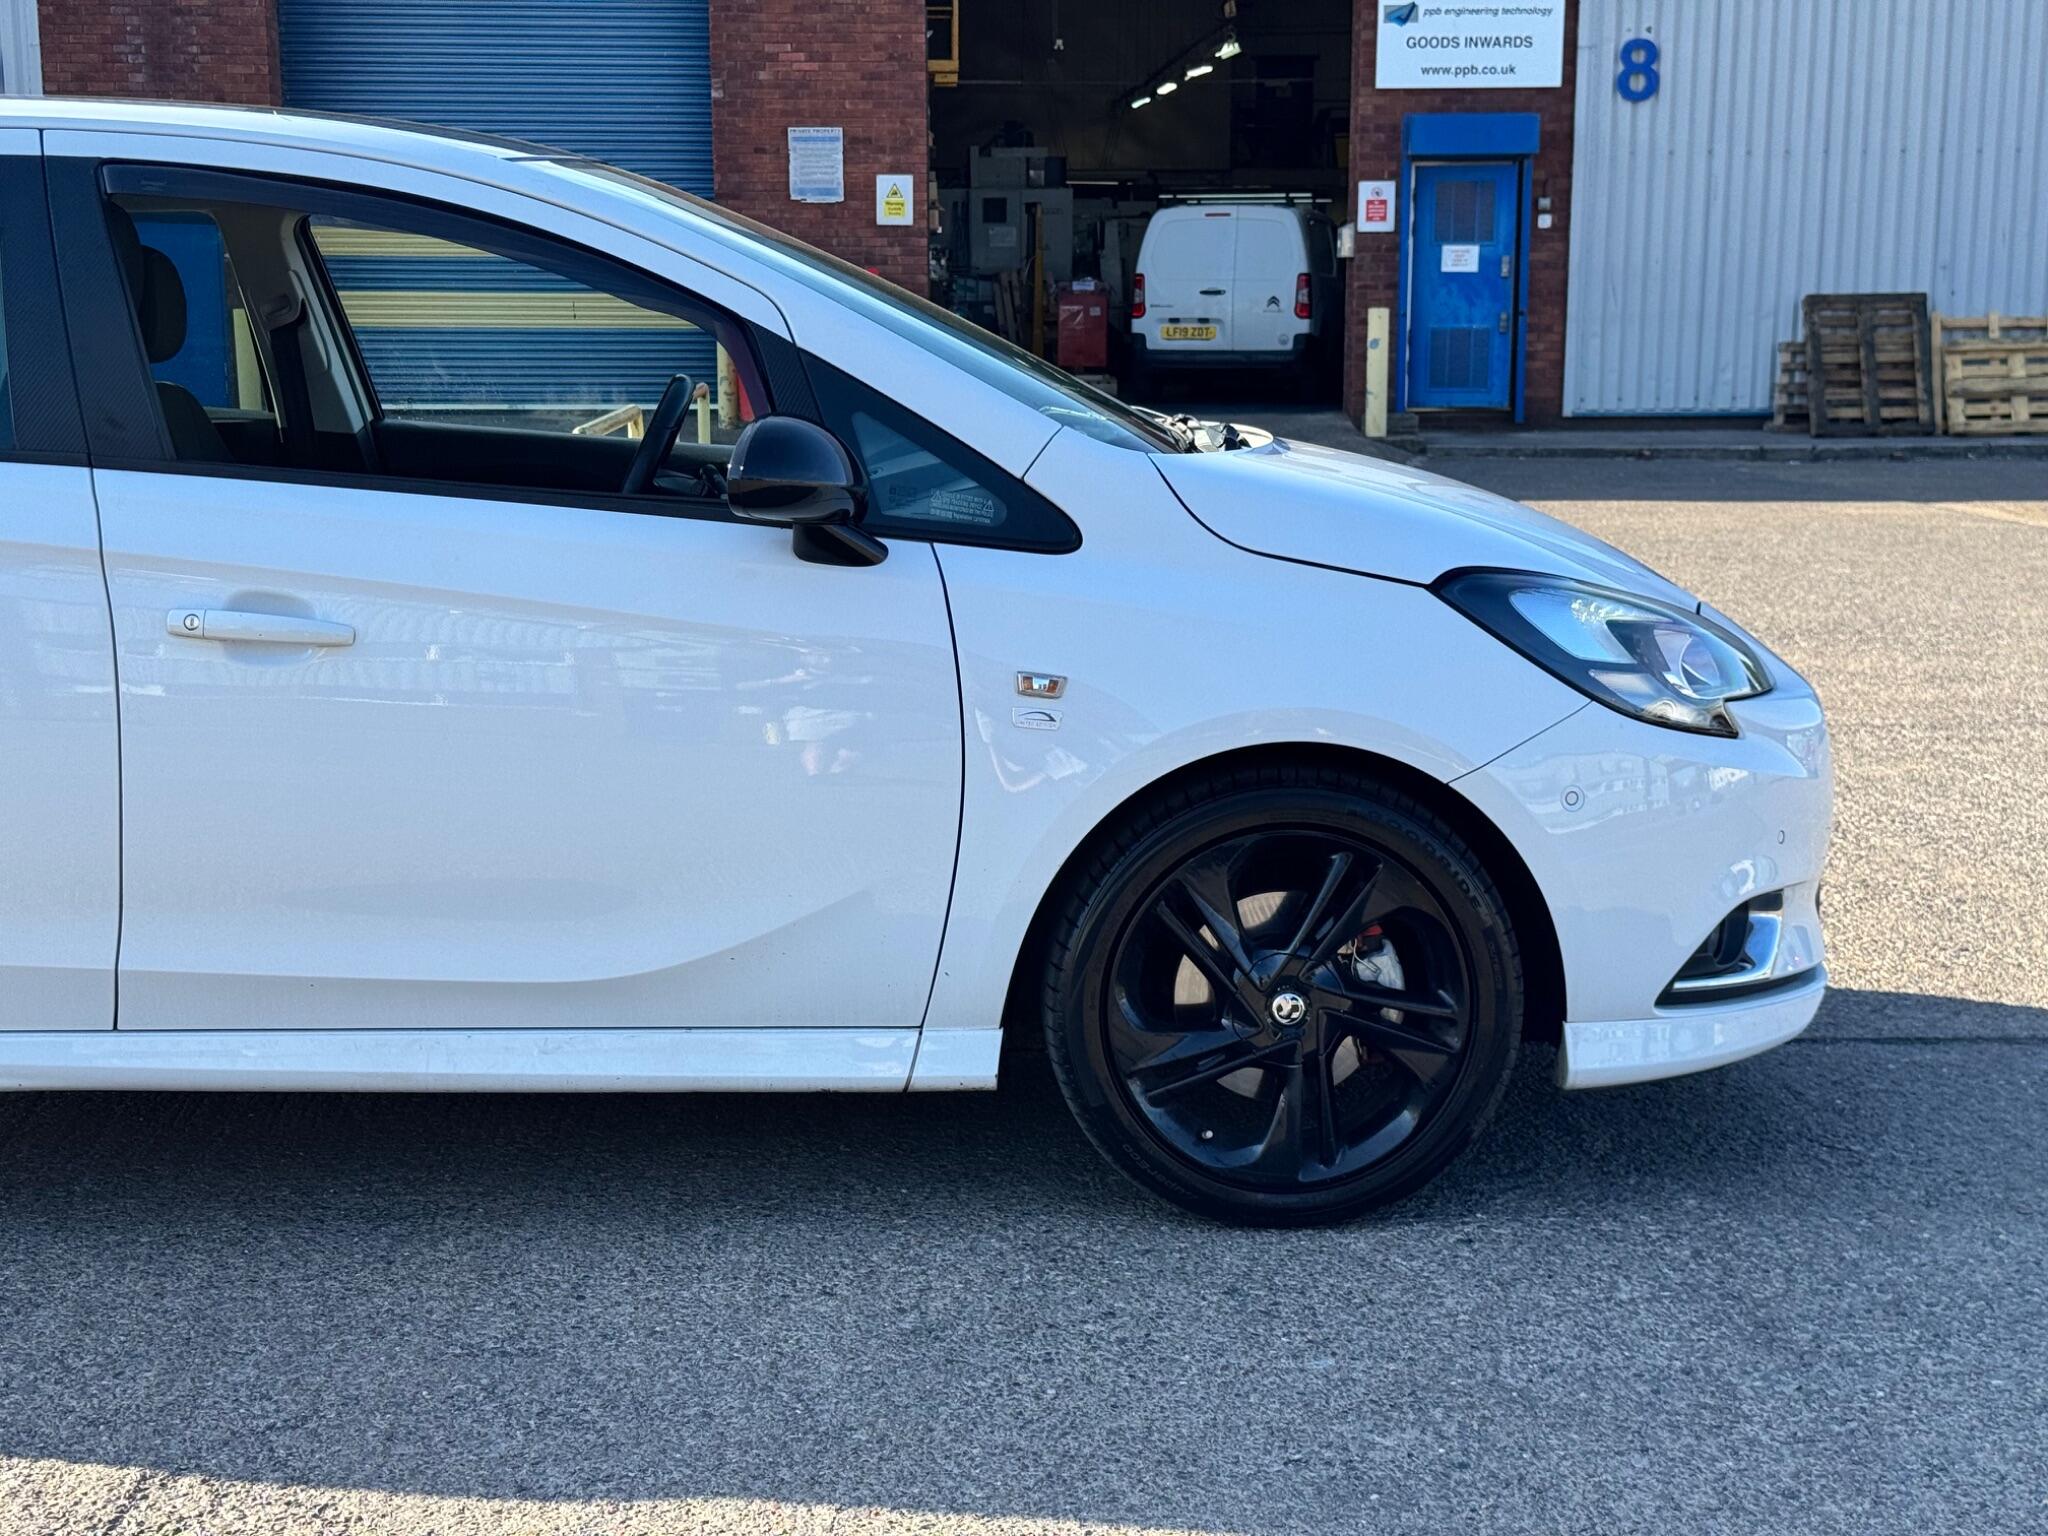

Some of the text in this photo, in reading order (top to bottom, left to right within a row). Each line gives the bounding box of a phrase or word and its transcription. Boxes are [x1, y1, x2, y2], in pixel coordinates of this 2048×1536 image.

[1423, 7, 1553, 17] ppb engineering technology
[1406, 36, 1533, 49] GOODS INWARDS
[1421, 65, 1516, 78] www.ppb.co.uk
[1617, 38, 1660, 102] 8
[1166, 327, 1188, 338] LF19
